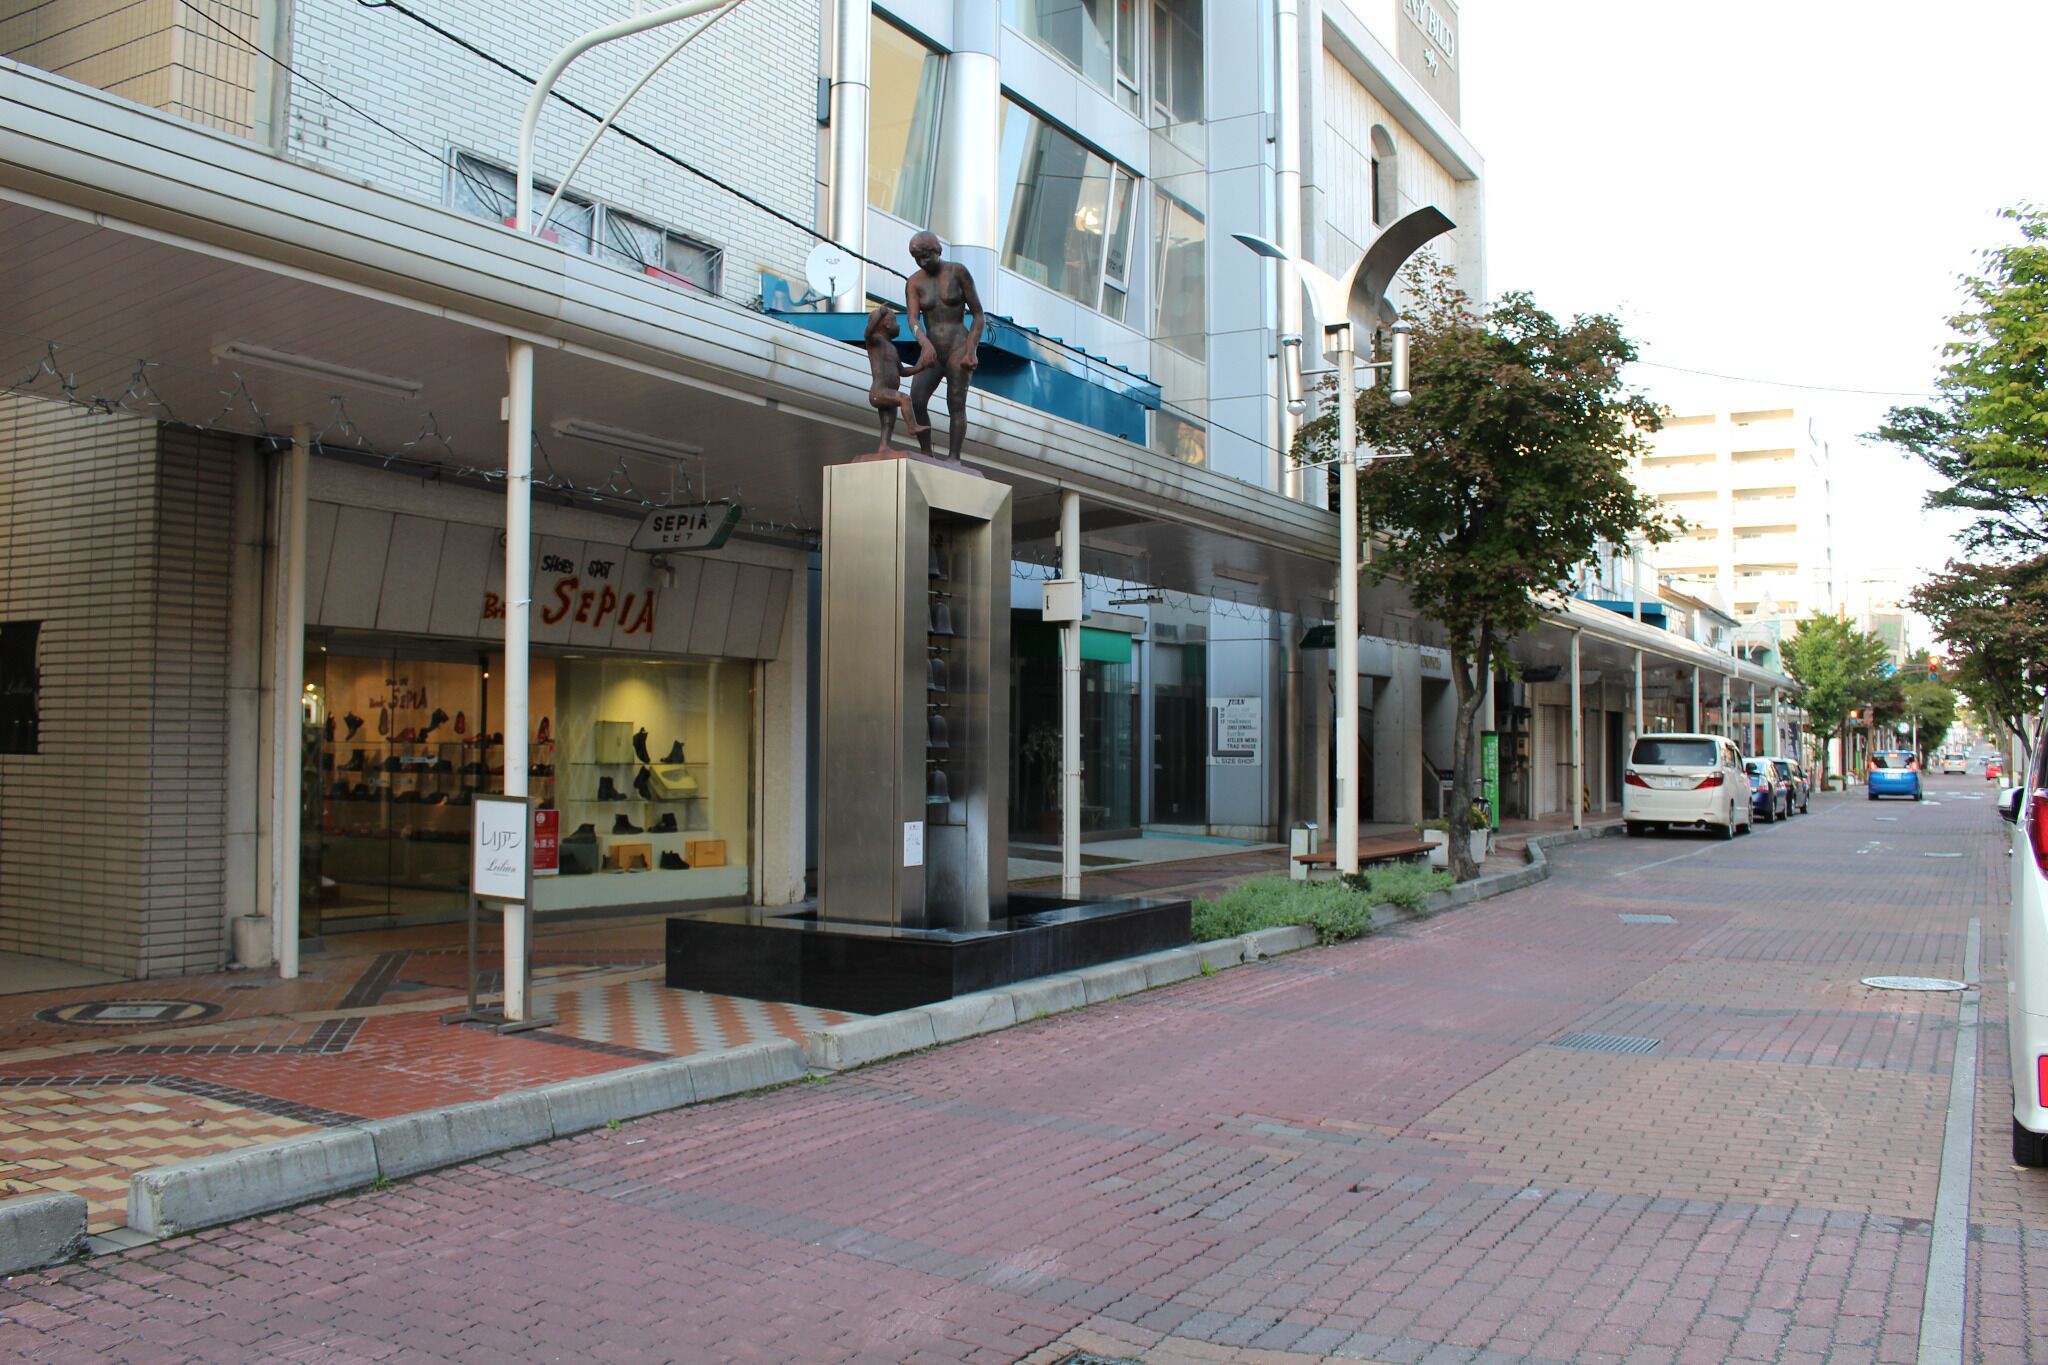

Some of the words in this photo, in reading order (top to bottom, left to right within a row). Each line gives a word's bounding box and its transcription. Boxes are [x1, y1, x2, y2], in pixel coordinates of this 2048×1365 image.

[652, 513, 708, 532] SEPIA
[541, 554, 575, 575] SHOES
[588, 559, 615, 580] SPOT
[542, 576, 657, 635] SEPIA
